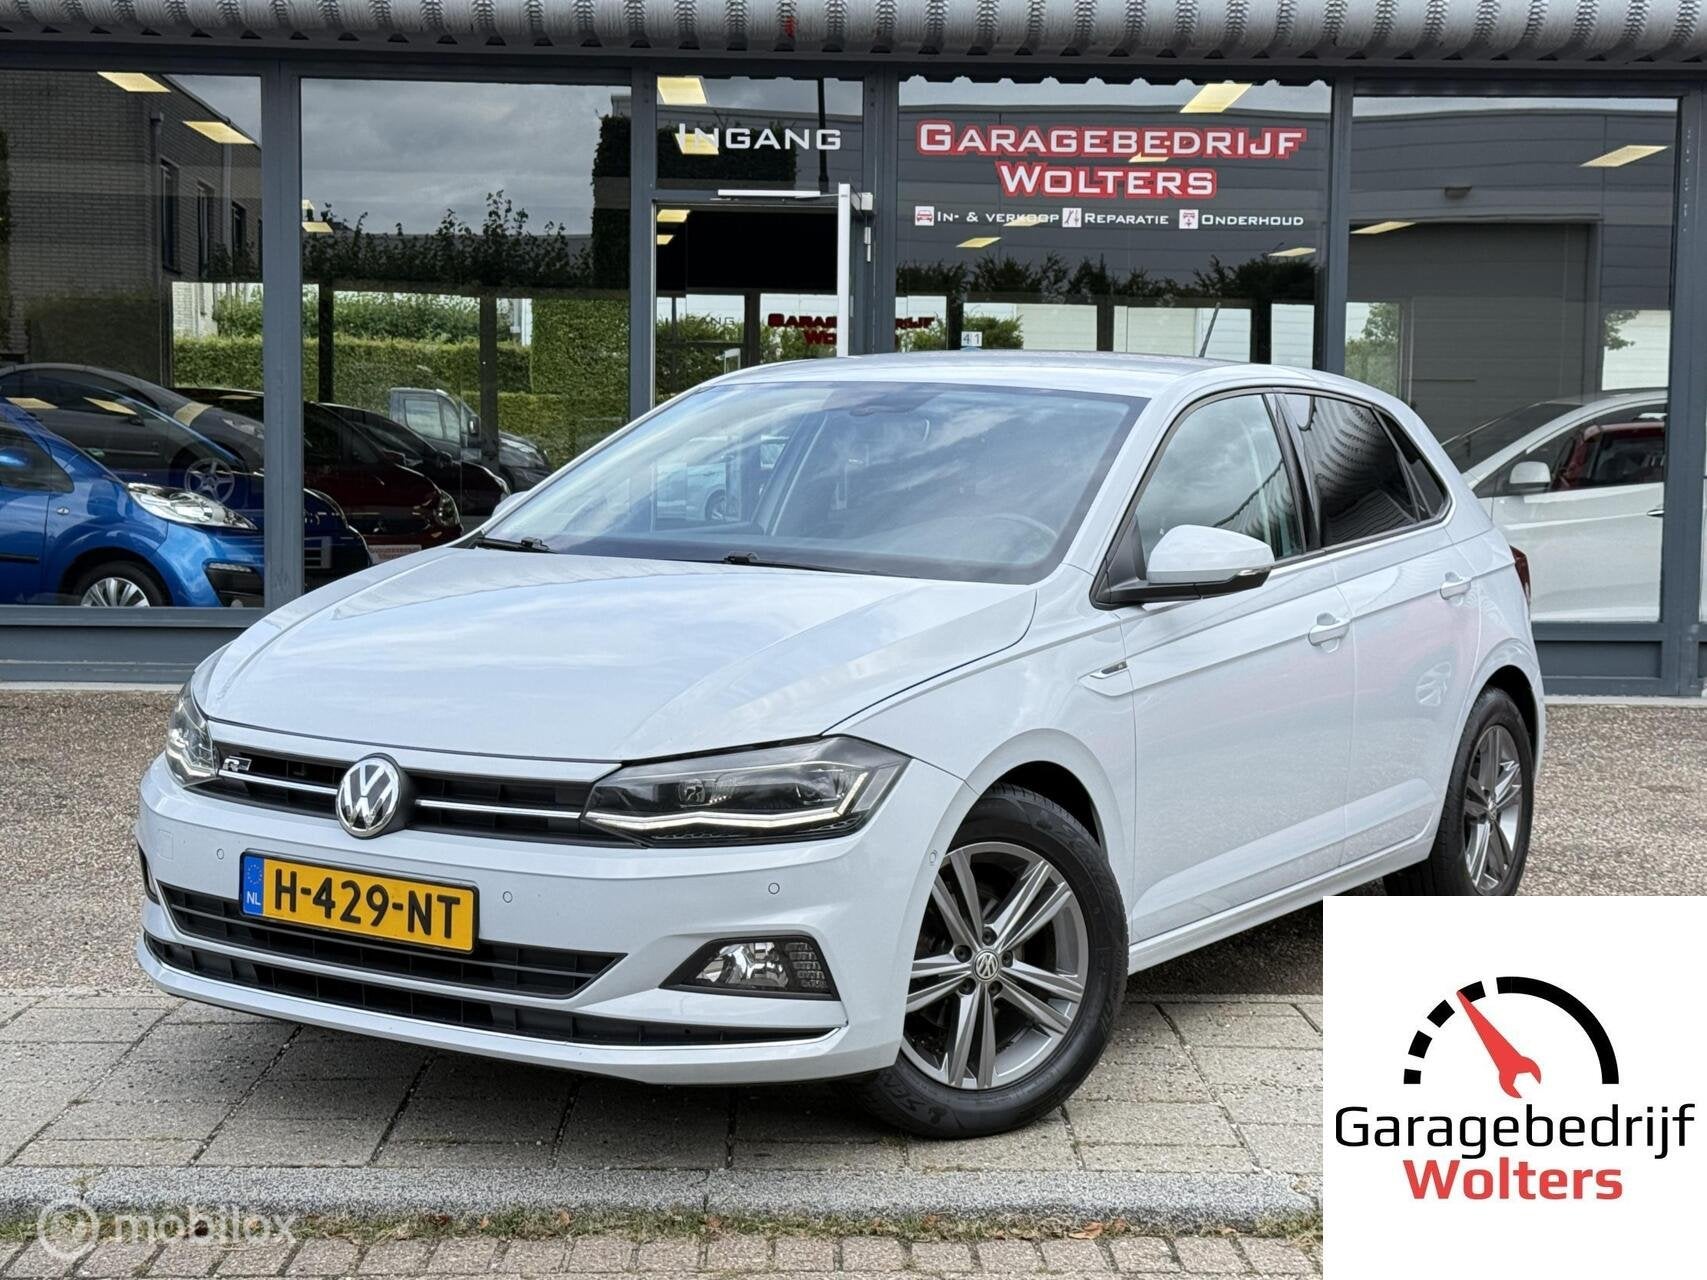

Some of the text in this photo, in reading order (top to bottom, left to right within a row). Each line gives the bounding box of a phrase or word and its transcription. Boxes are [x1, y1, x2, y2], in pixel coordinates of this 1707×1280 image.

[679, 123, 841, 150] INGANG
[917, 120, 1307, 158] GARAGEBEDRIJF
[998, 162, 1216, 198] WOLTERS
[966, 212, 980, 223] &
[985, 213, 1060, 224] VERKOOP
[1084, 211, 1170, 225] REPARATIE
[1200, 213, 1304, 226] ONDERHOUD
[962, 333, 981, 345] 41
[246, 890, 261, 906] NL
[274, 868, 461, 939] H-429-NT
